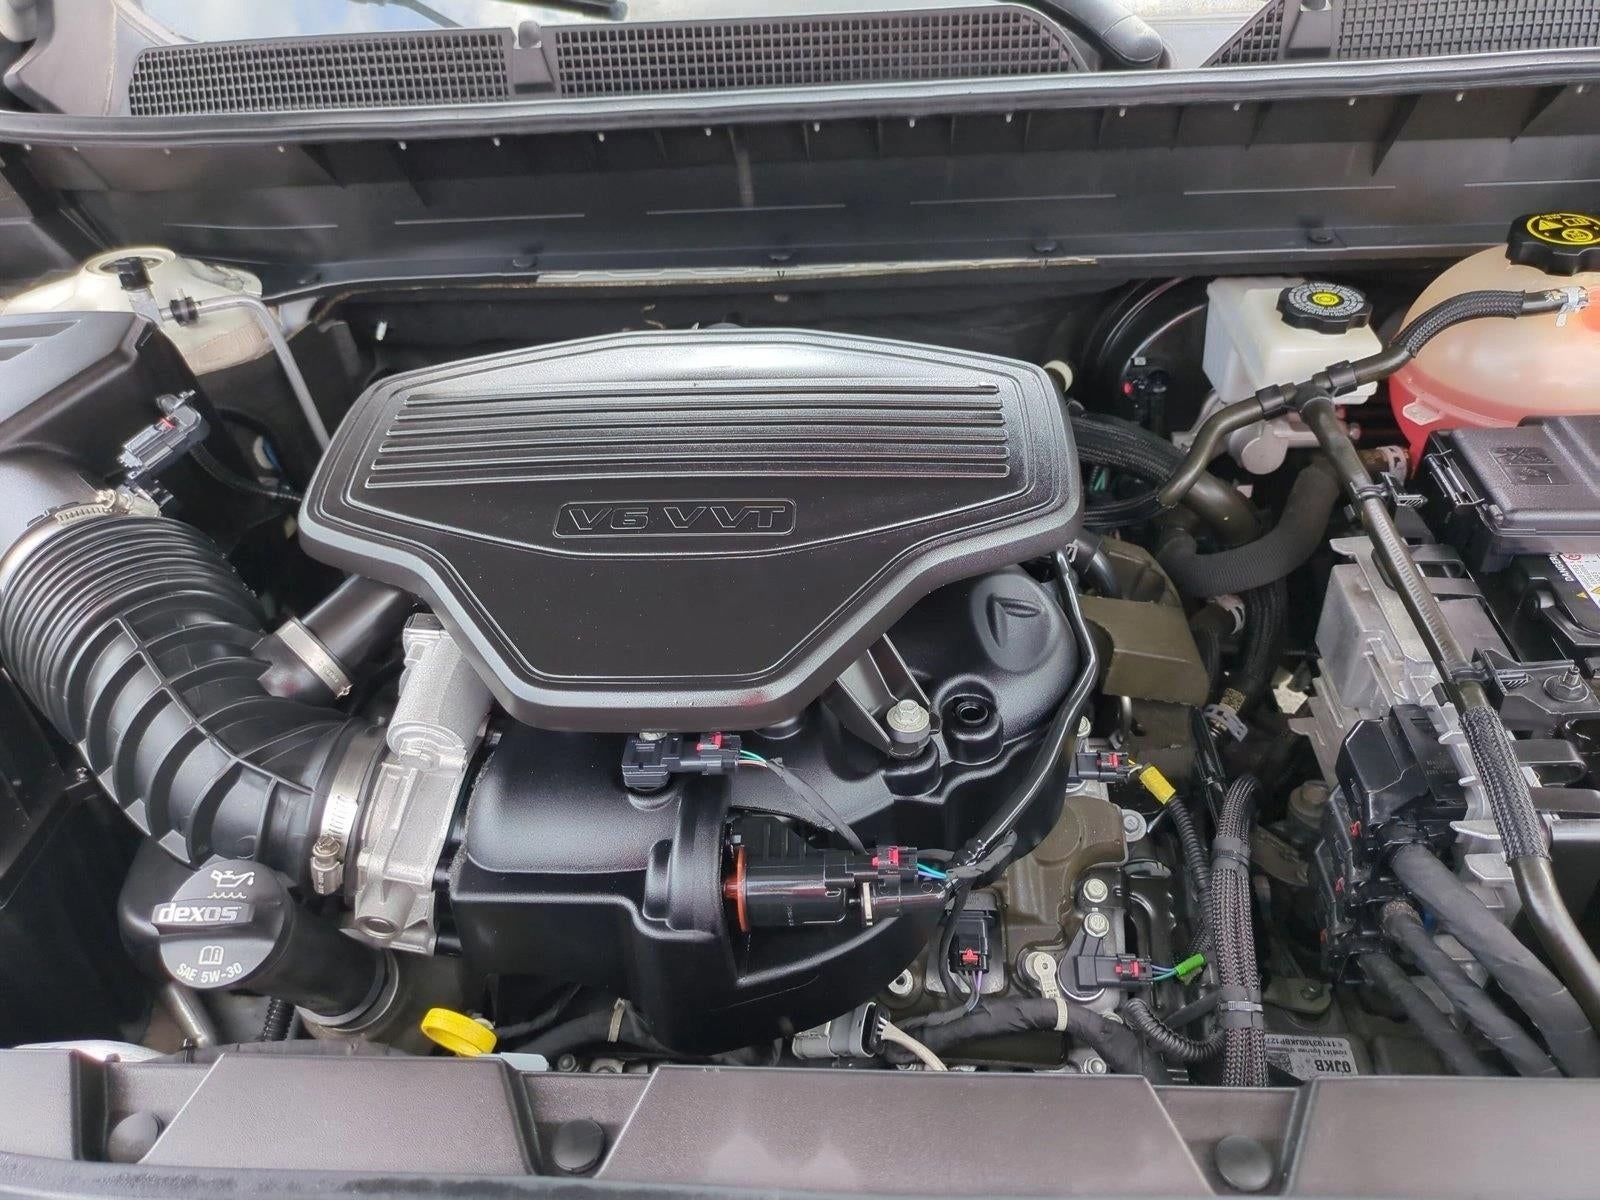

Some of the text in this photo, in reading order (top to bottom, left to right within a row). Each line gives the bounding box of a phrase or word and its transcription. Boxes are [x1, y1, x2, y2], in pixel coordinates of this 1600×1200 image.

[568, 505, 786, 530] V6 VVT
[158, 902, 242, 922] dexos
[176, 962, 243, 984] SAE 5W-30
